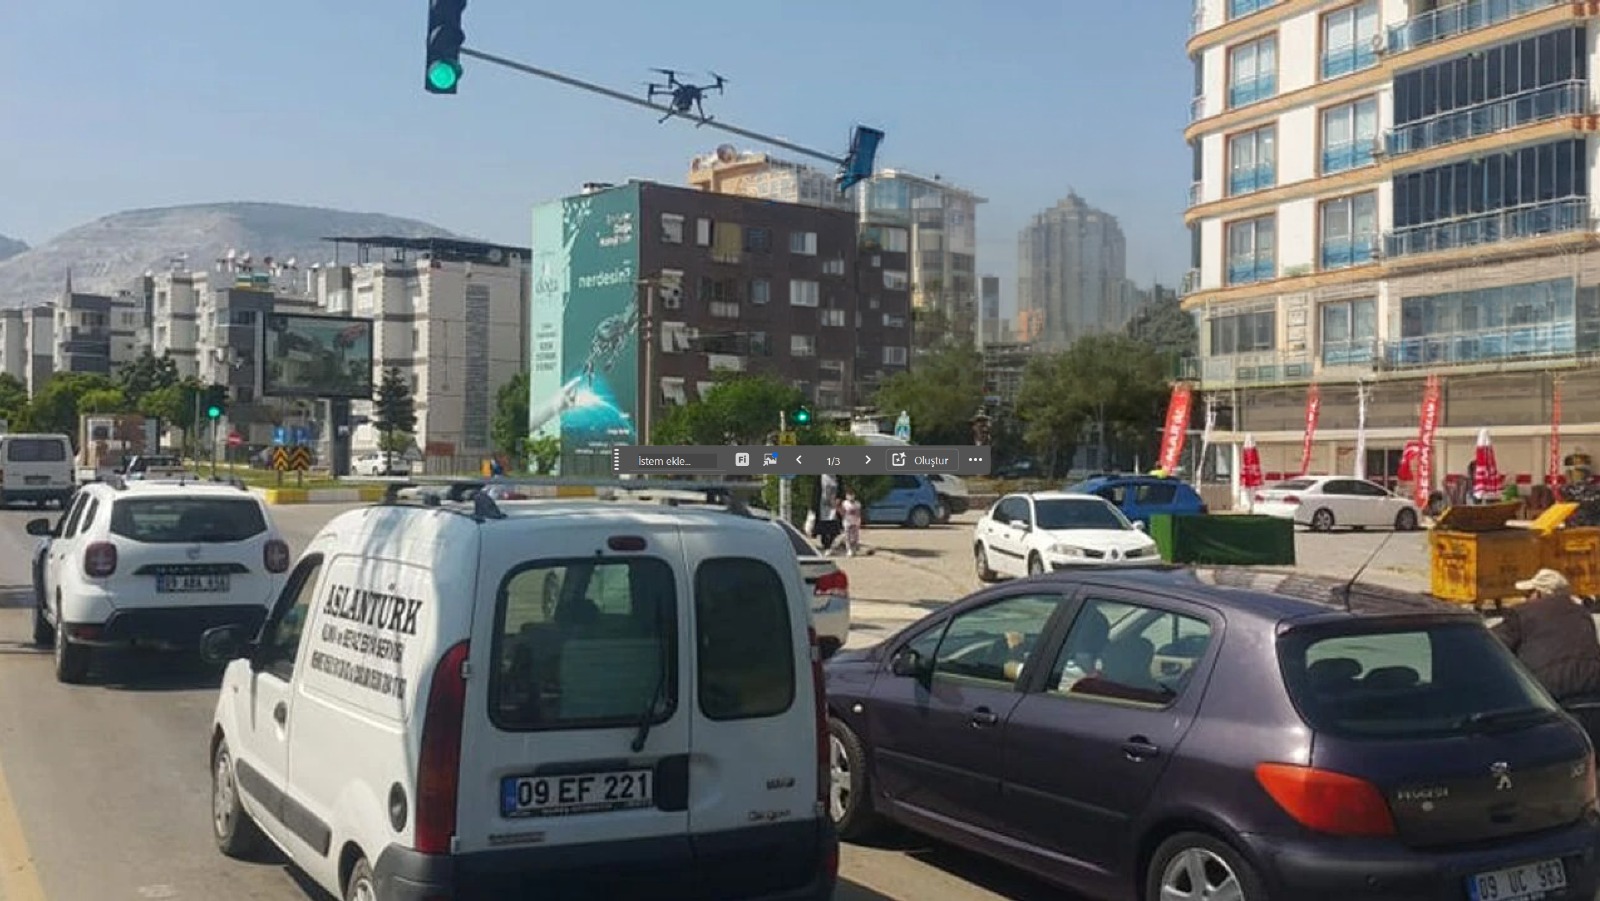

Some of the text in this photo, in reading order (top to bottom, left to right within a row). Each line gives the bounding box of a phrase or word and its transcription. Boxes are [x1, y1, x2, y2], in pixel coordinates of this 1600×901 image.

[517, 772, 648, 807] 09 EF 221
[1480, 875, 1498, 899] 09
